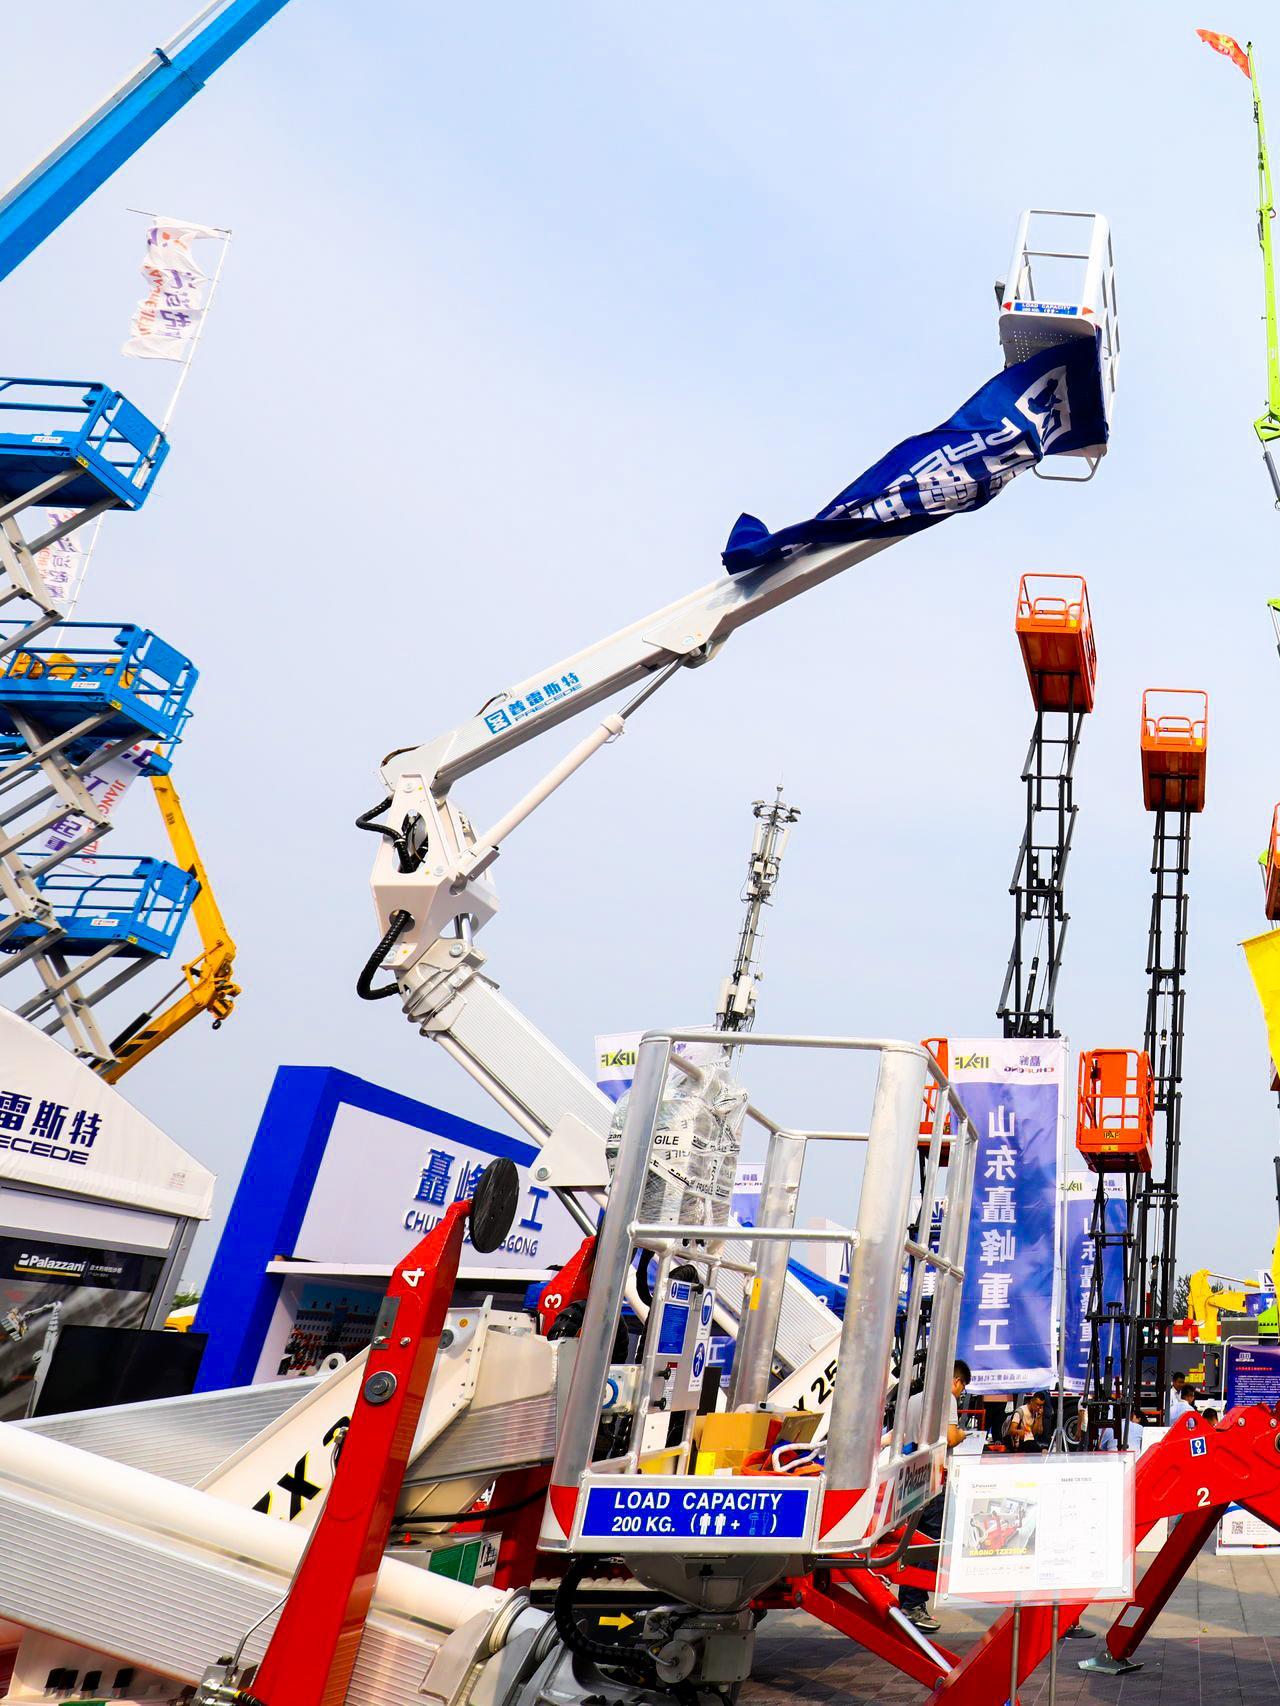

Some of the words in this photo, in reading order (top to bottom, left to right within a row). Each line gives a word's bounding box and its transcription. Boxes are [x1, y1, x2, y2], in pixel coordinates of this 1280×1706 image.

[509, 672, 580, 716] 普雷斯特
[0, 1091, 102, 1148] 雷斯特
[654, 1135, 679, 1146] GILE
[29, 1255, 86, 1272] Palazzani
[402, 1267, 425, 1287] 4
[544, 1294, 562, 1309] 3
[614, 1491, 671, 1509] LOAD
[682, 1492, 783, 1510] CAPACITY
[1196, 1487, 1211, 1507] 2
[611, 1516, 641, 1532] 200
[645, 1516, 676, 1532] KG.
